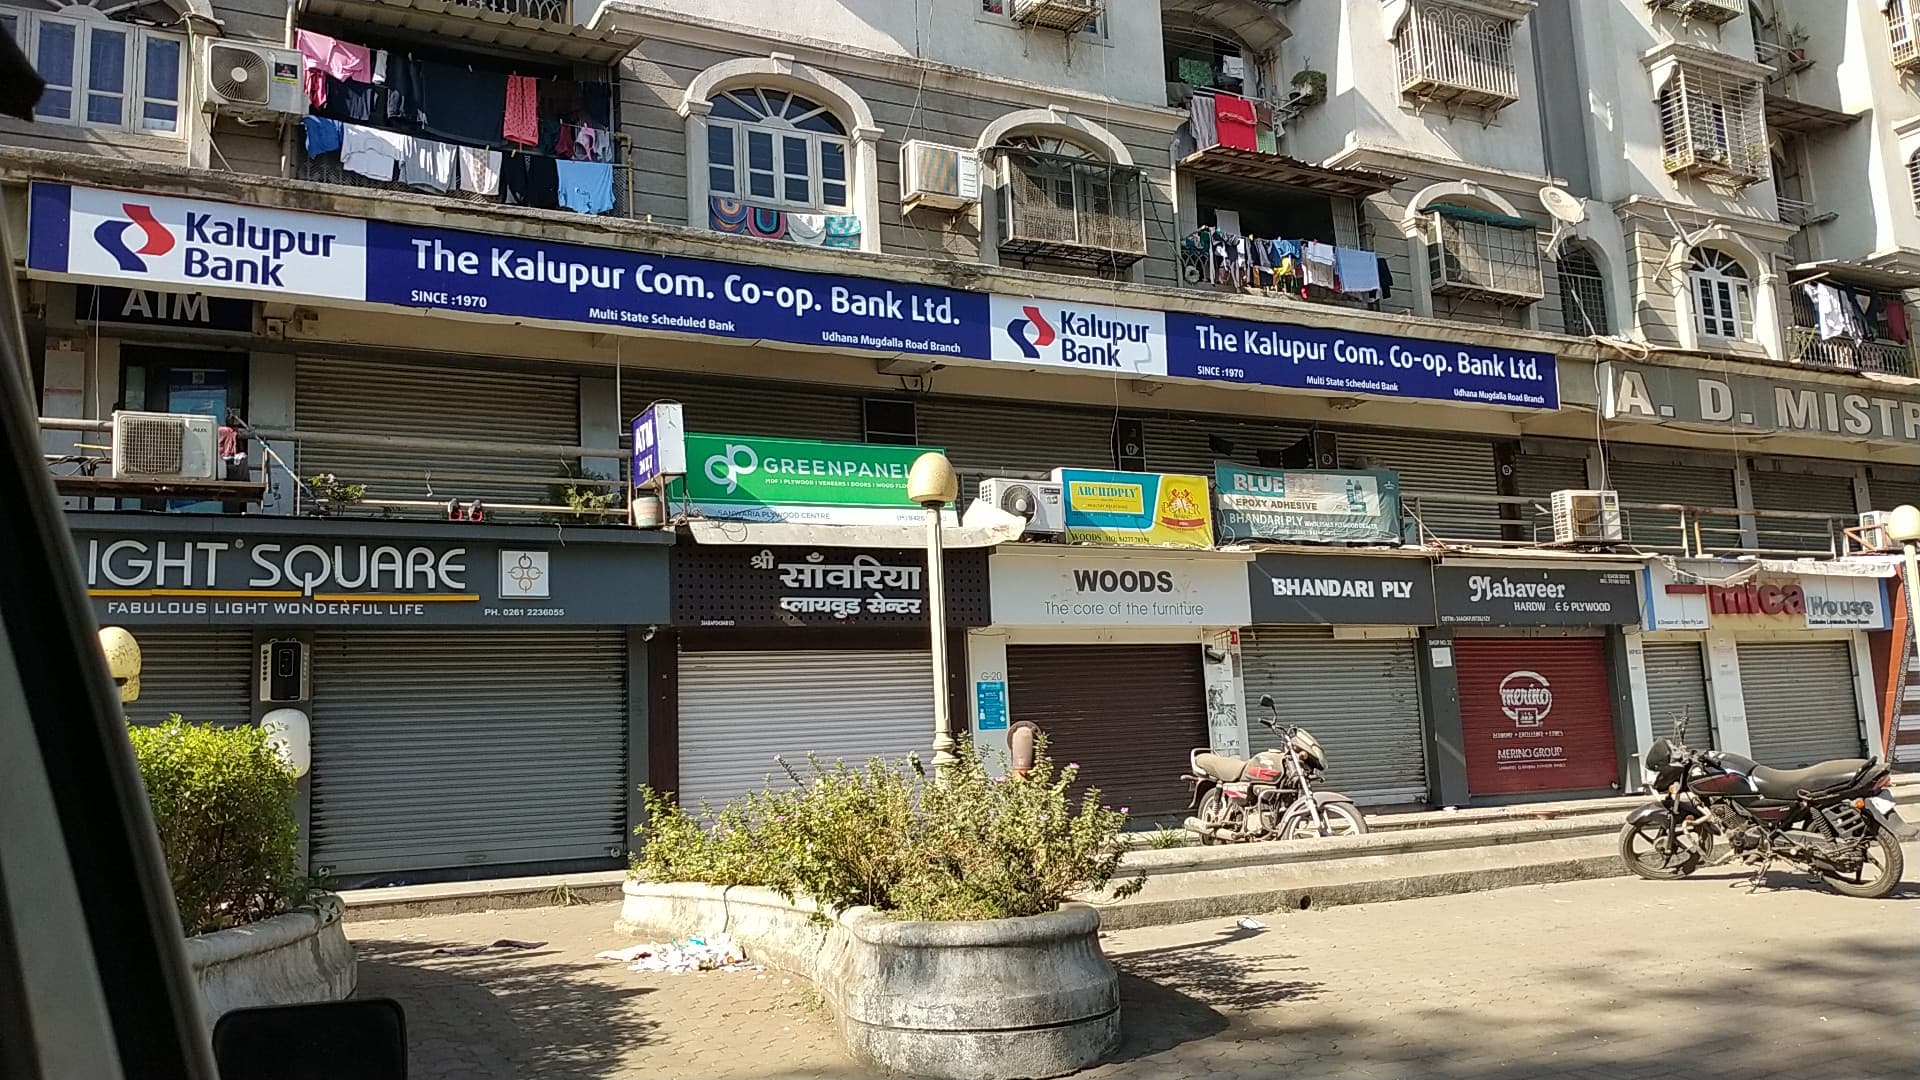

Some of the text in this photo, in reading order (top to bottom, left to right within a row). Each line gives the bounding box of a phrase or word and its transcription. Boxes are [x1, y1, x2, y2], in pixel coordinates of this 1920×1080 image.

[185, 211, 337, 260] Kalupur
[183, 247, 285, 287] Bank
[411, 238, 961, 326] The Kalupur Com. Co-op. Bank Ltd.
[411, 289, 487, 308] SINCE :1970
[589, 307, 735, 333] Multi State Scheduled Bank
[1061, 310, 1150, 346] Kalupur
[822, 330, 961, 354] Udhana Mugdalla Road Branch
[1061, 338, 1122, 368] Bank
[1195, 325, 1543, 381] The Kalupur Com. Co-op. Bank Ltd.
[1197, 365, 1244, 378] SINCE :1970
[1306, 375, 1399, 391] Multi State Scheduled Bank
[1453, 388, 1478, 398] Udhana
[1507, 393, 1523, 401] Road
[1523, 394, 1545, 404] Branch
[1617, 369, 1675, 418] A.
[1697, 378, 1753, 424] D.
[635, 419, 654, 456] ATM
[763, 456, 911, 479] GREENPANEL
[1233, 473, 1285, 493] BLUE
[1235, 498, 1318, 511] EPOXY ADHESIVE
[801, 511, 831, 520] CENTRE
[1229, 512, 1283, 525] BHANDARI
[1285, 516, 1303, 527] PLY
[1071, 532, 1102, 542] WOODS
[87, 540, 466, 596] IGHT SQUARE
[750, 549, 774, 569] श्री
[1073, 570, 1173, 593] WOODS
[1271, 577, 1413, 598] BHANDARI PLY
[1468, 574, 1566, 602] Mahaveer
[108, 602, 424, 616] FABULOUS LIGHT WONDERFUL LIFE
[484, 608, 500, 617] PH.
[503, 609, 524, 617] 0261
[1045, 601, 1204, 617] The core of the furniture
[1570, 602, 1611, 613] PLYWOOD
[980, 671, 1003, 681] G-20
[1501, 683, 1551, 706] merino
[1497, 746, 1563, 760] MERINO GROUP
